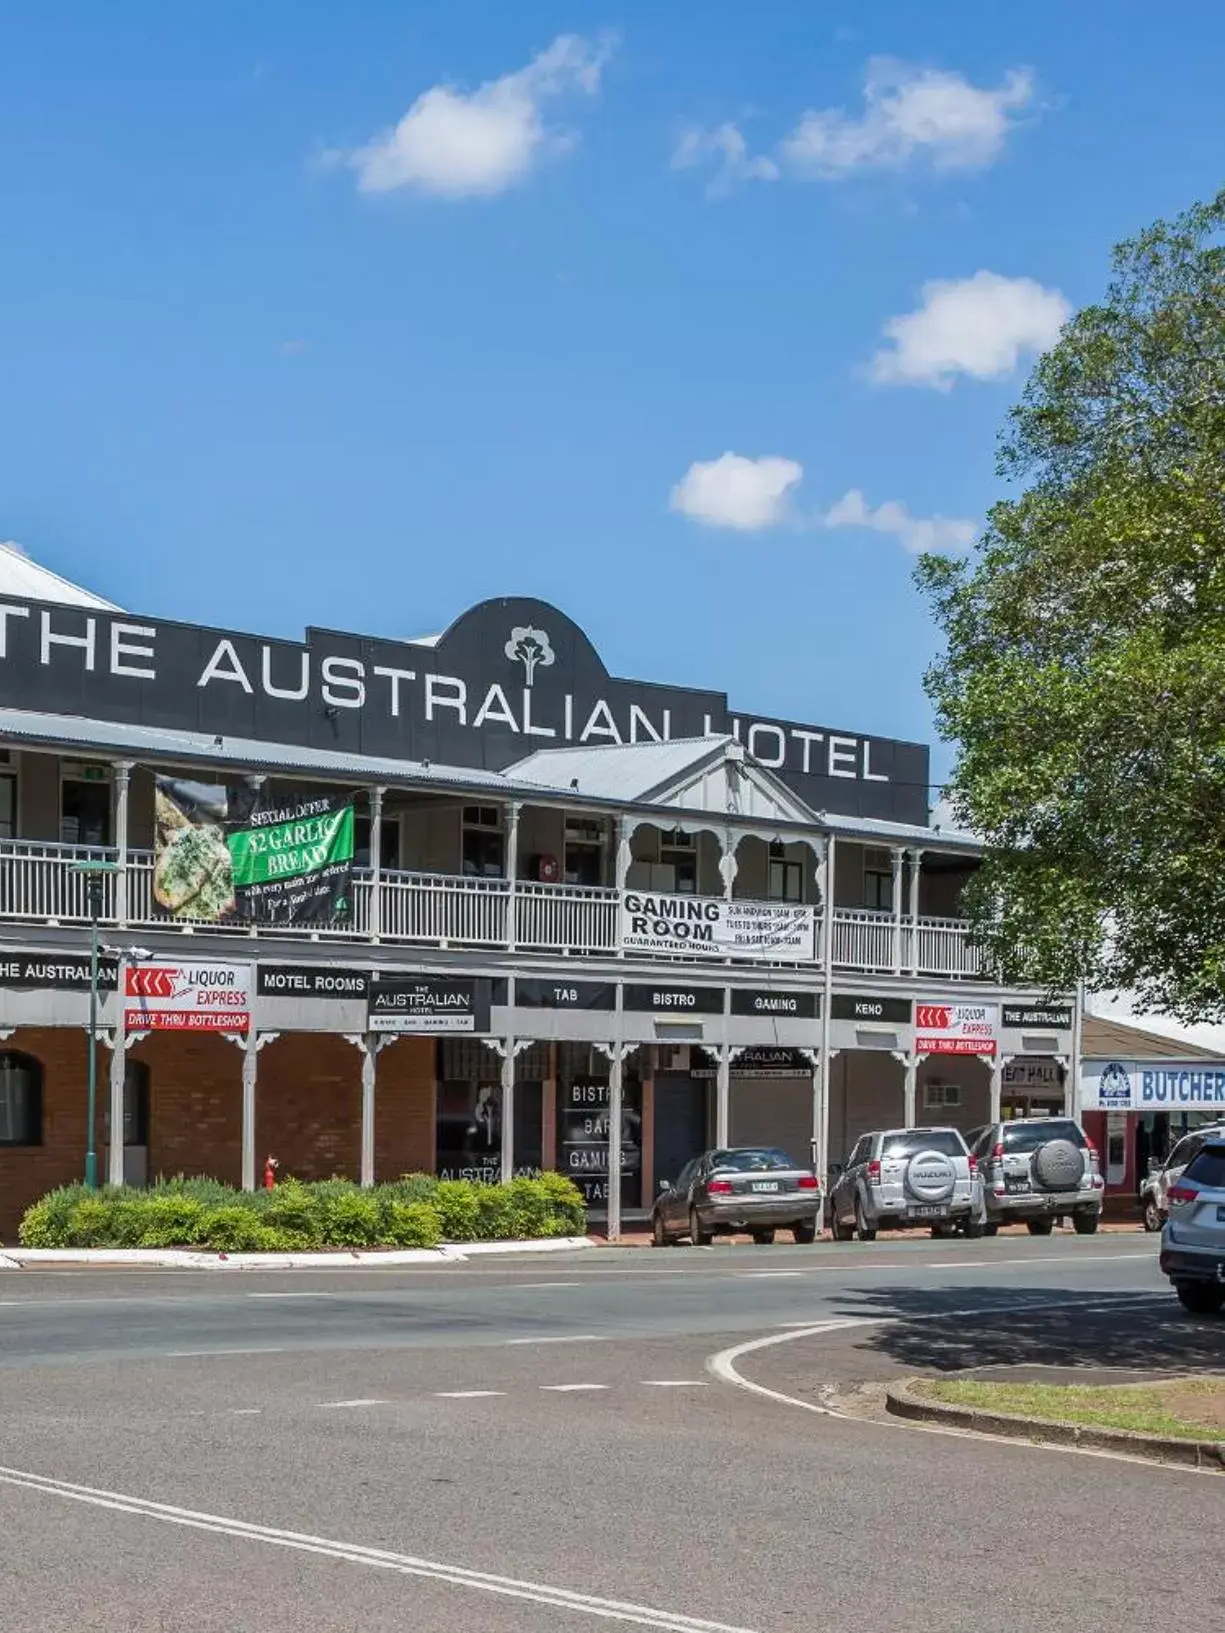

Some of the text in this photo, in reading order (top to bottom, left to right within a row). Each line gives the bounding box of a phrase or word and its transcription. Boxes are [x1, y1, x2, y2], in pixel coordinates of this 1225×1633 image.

[196, 639, 671, 743] AUSTRALIAN
[704, 714, 890, 782] HOTEL
[250, 799, 330, 826] SPECIAL OFFER
[248, 818, 336, 853] $2 GARLIC
[268, 846, 328, 876] BREAD
[625, 894, 720, 922] GAMING
[632, 917, 714, 941] ROOM
[624, 936, 720, 952] GUARANTEED HOURS
[25, 964, 116, 980] AUSTRALAN
[188, 970, 234, 986] LIQUOR
[264, 974, 366, 991] MOTEL ROOMS
[197, 990, 247, 1005] EXPRESS
[375, 994, 470, 1006] AUSTRALIAN
[553, 989, 578, 1000] TAB
[653, 993, 696, 1006] BISTRO
[754, 997, 796, 1010] GAMING
[855, 1003, 883, 1015] KENO
[128, 1013, 247, 1027] DRIVE THRU BOTTLESHOP
[1005, 1011, 1070, 1024] THE AUSTRALIAN
[962, 1023, 992, 1035] EXPRESS
[572, 1086, 625, 1101] BIST
[1142, 1071, 1225, 1101] BUTCHER
[569, 1151, 626, 1167] GAMIG
